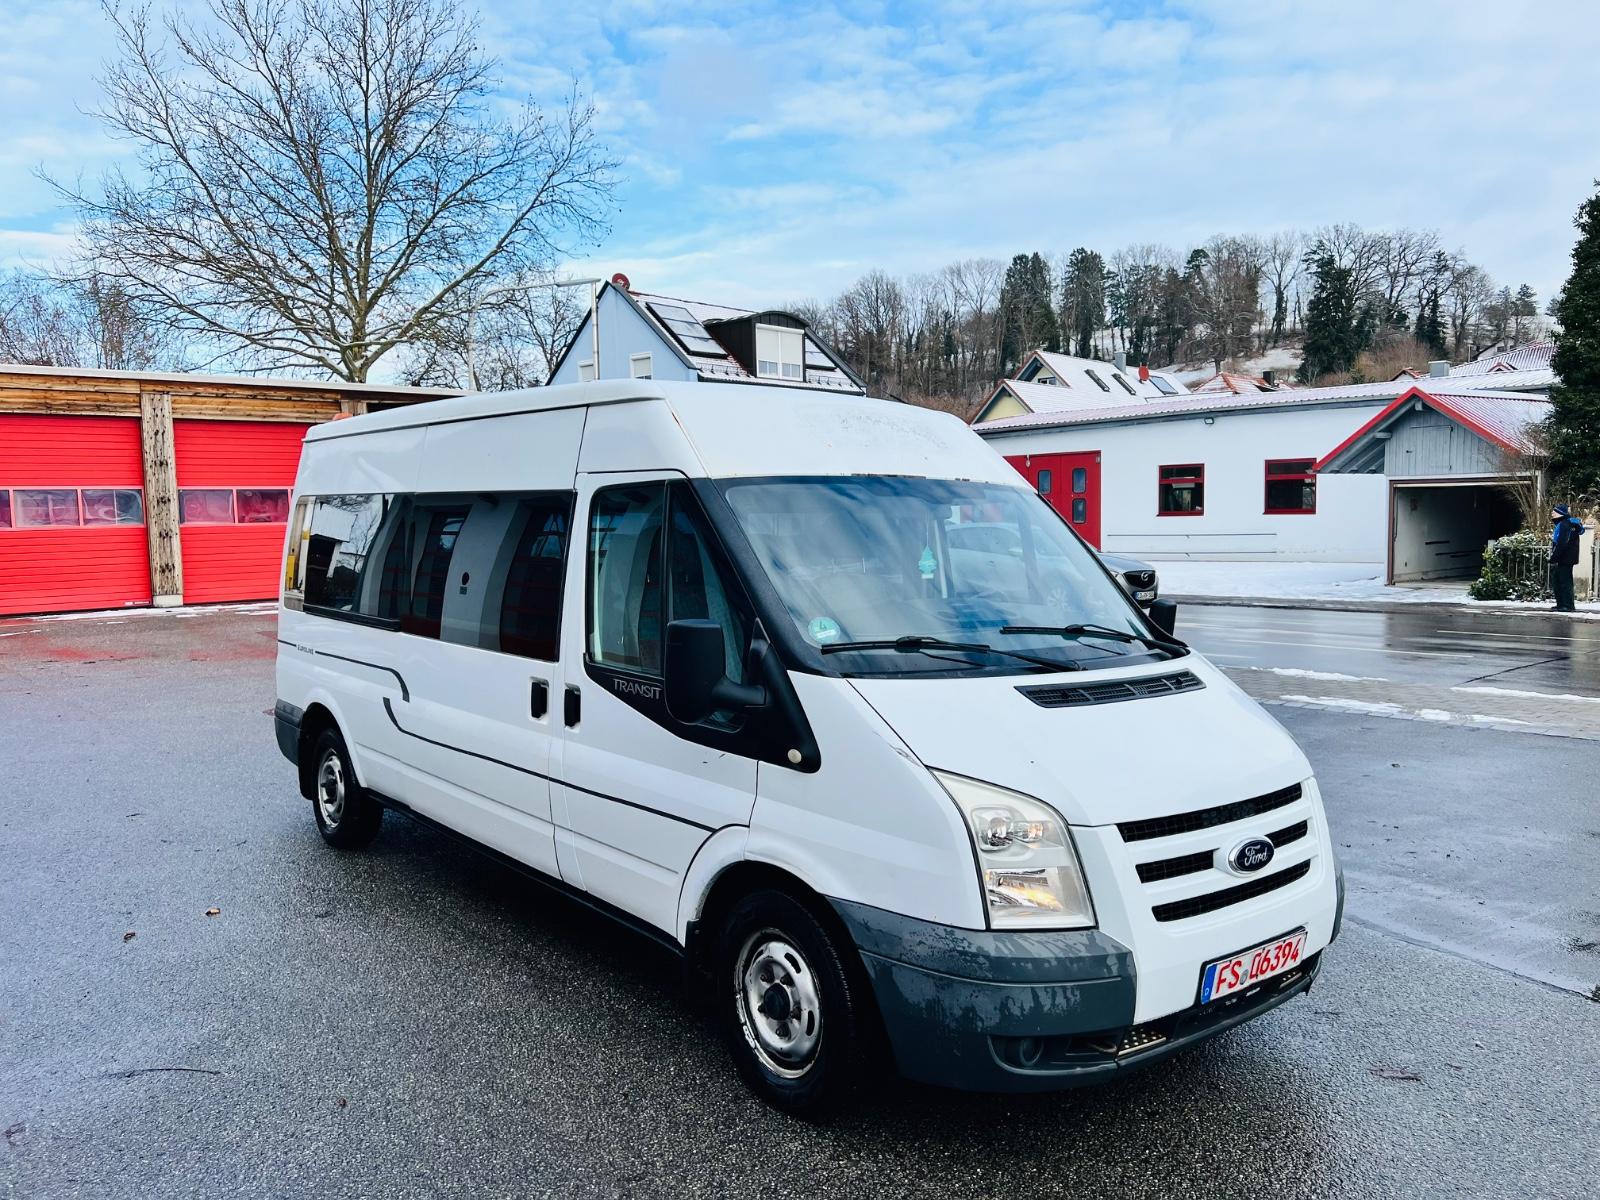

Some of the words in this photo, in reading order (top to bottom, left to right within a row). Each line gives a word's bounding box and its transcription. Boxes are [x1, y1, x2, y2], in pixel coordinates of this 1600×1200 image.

[613, 678, 662, 700] TRANSIT
[1244, 845, 1268, 867] Ford
[1215, 960, 1242, 994] FS
[1249, 937, 1302, 980] 06394
